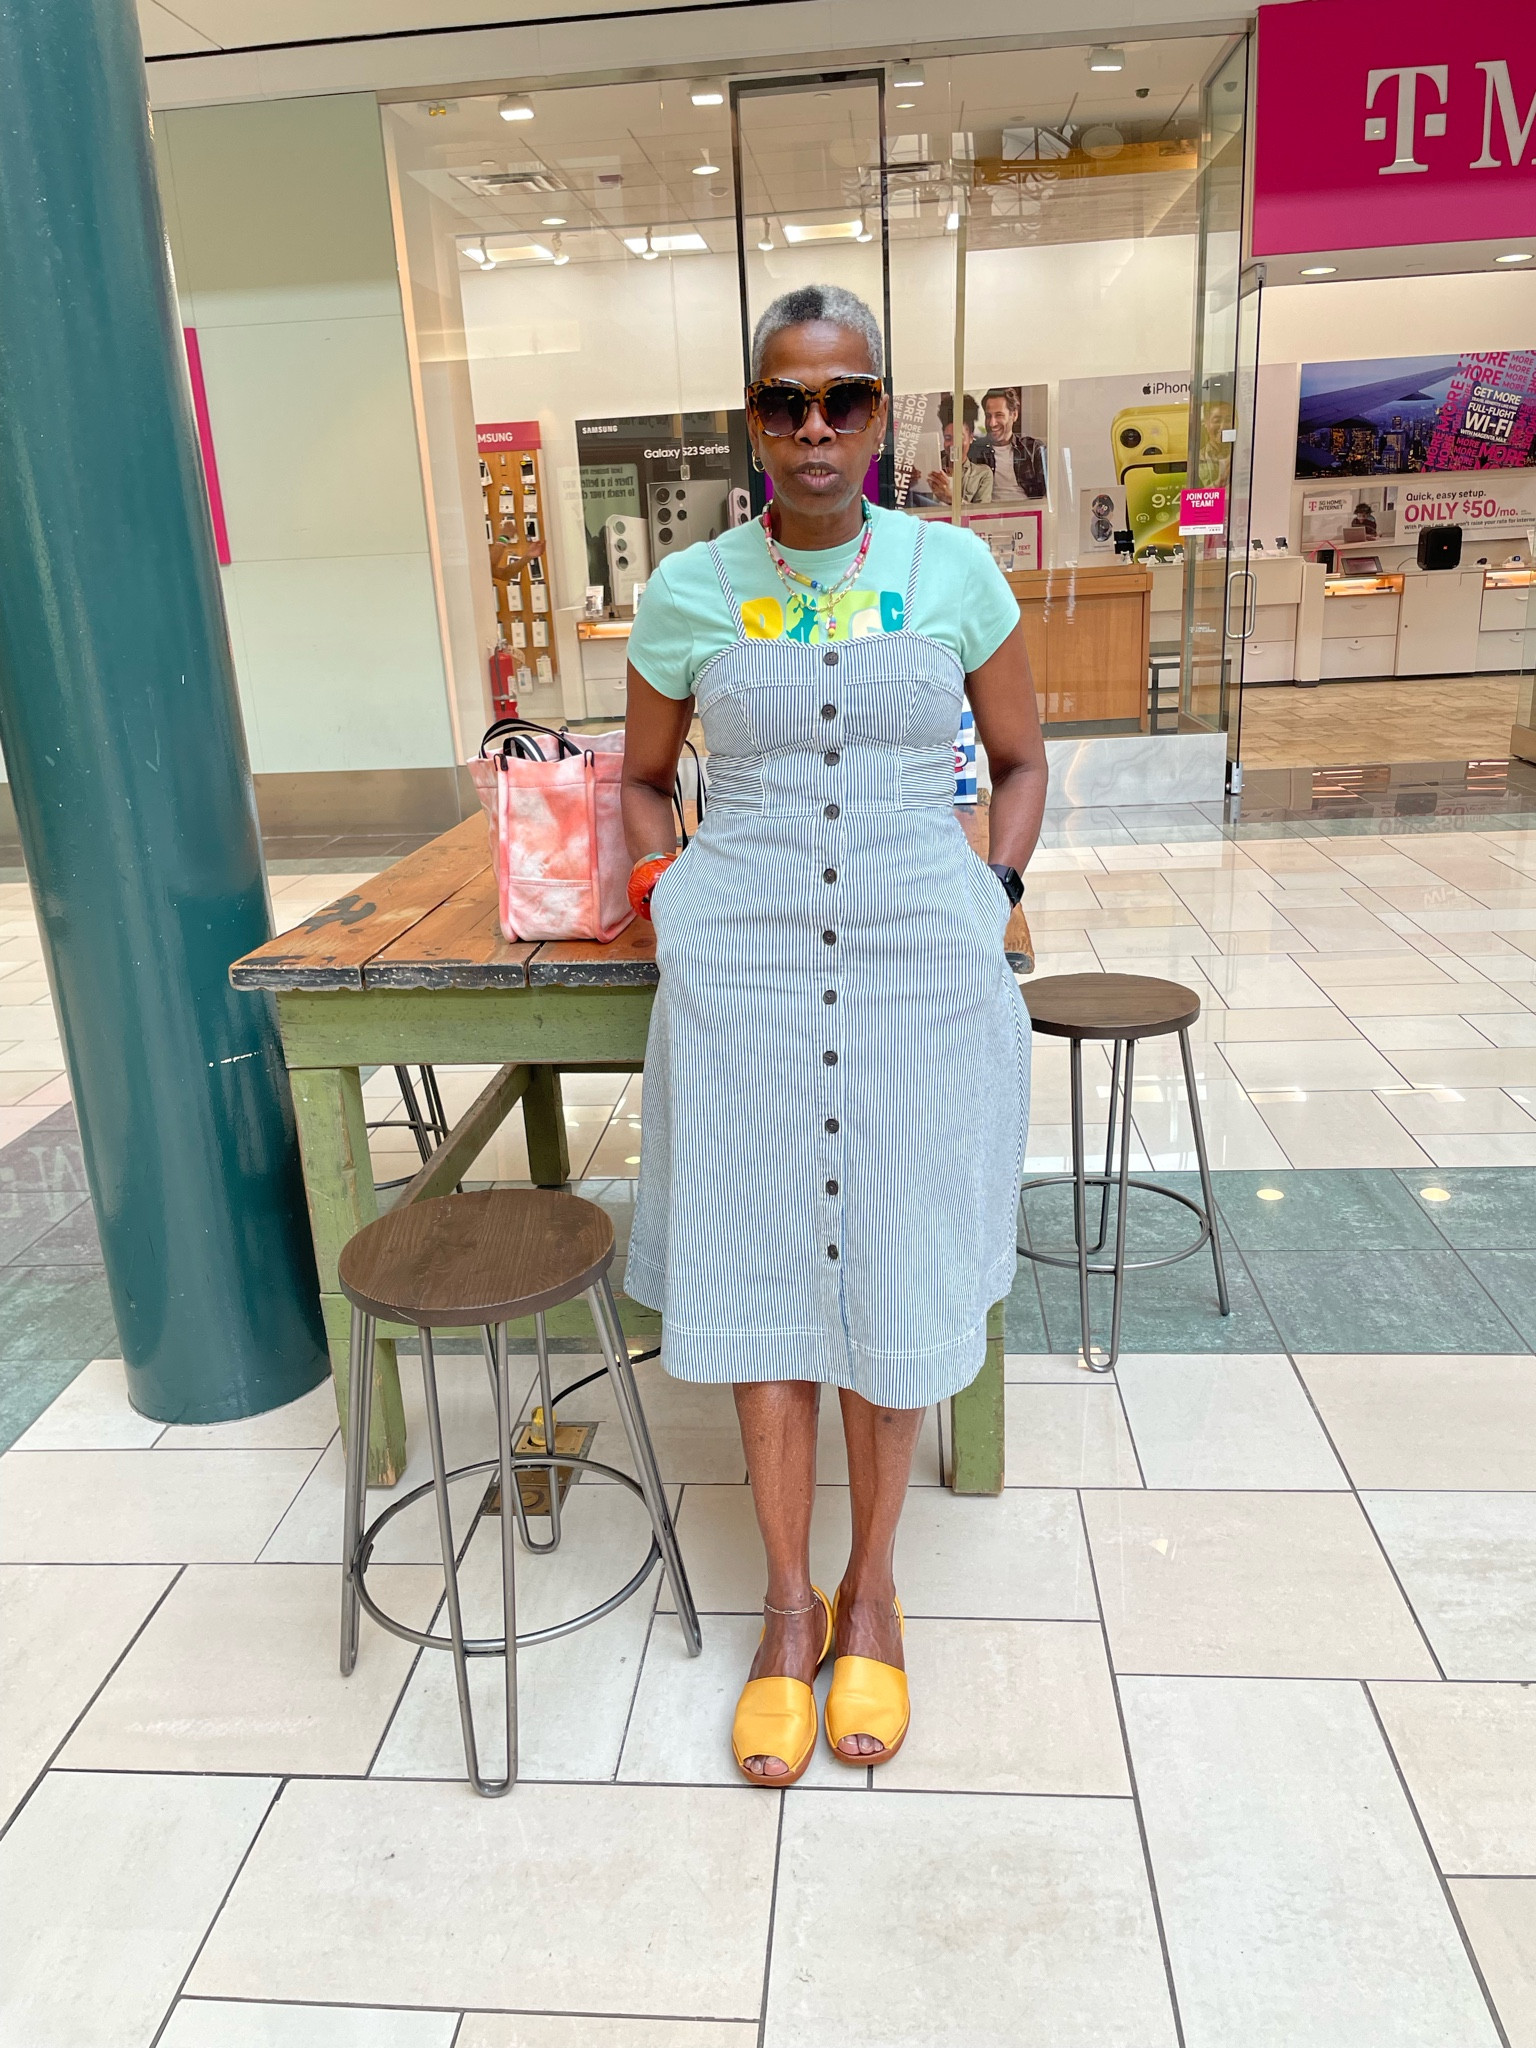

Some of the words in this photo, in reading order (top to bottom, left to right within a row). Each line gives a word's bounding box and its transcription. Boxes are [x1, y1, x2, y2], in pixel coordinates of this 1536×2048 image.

[1511, 354, 1535, 366] MORE
[1508, 363, 1532, 375] MORE
[1505, 372, 1529, 384] MORE
[1473, 386, 1494, 399] GET
[1493, 390, 1522, 405] MORE
[1436, 379, 1466, 432] MORE
[1467, 402, 1517, 420] FULL-FLIGHT
[582, 425, 618, 435] SAMSUNG
[900, 421, 923, 433] MORE
[1465, 411, 1514, 438] WI-FI
[898, 430, 921, 441] MORE
[644, 448, 680, 459] Galaxy
[699, 444, 730, 455] Series
[1185, 492, 1203, 501] JOIN
[1203, 491, 1220, 500] OUR
[1406, 492, 1435, 501] Quick,
[1436, 492, 1457, 500] easy
[1458, 489, 1487, 499] setup.
[1190, 500, 1214, 508] TEAM!
[1404, 502, 1459, 523] ONLY
